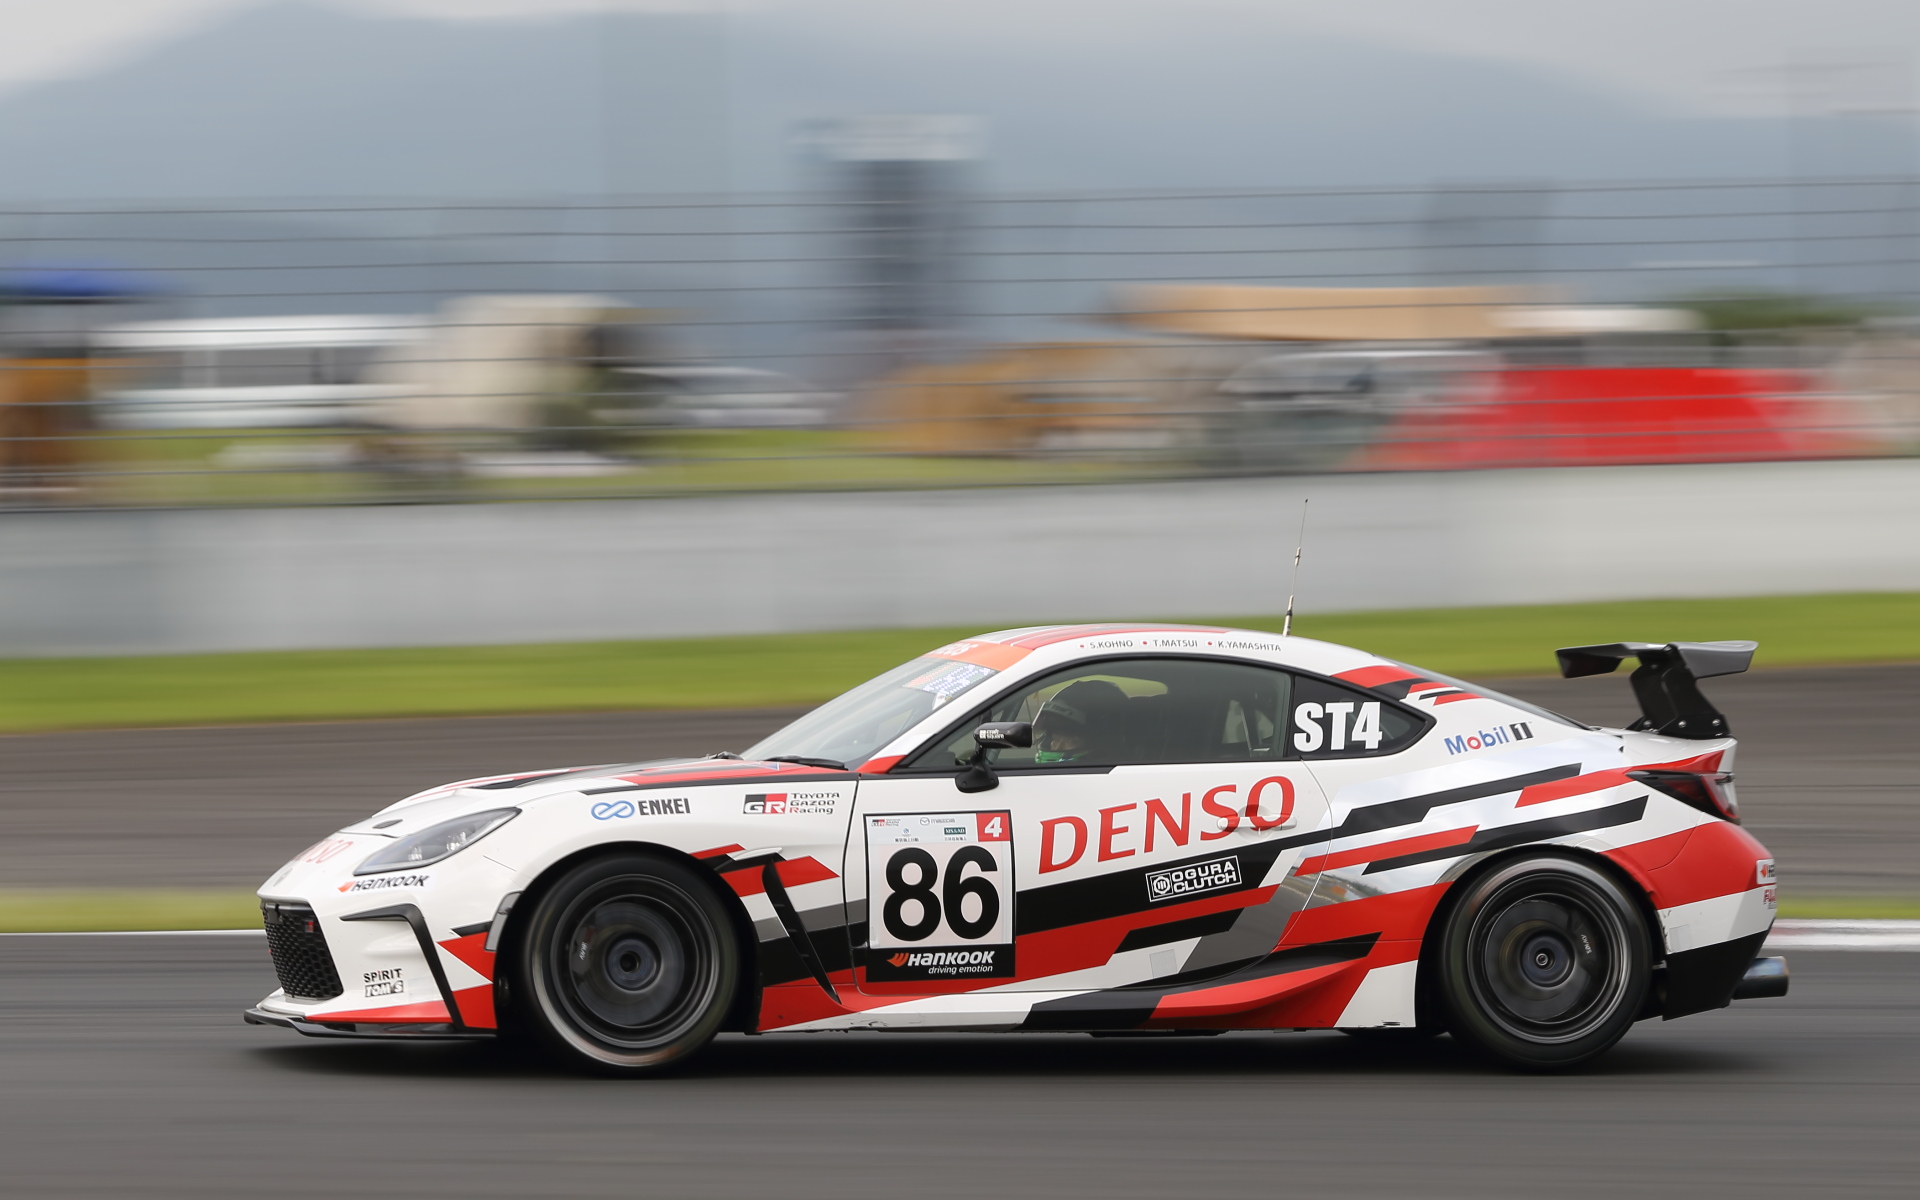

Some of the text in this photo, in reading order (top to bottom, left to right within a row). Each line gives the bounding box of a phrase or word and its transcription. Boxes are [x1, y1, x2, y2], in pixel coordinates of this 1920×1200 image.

[1089, 639, 1134, 649] S.KOHNO
[1153, 639, 1198, 648] T.MATSUI
[1217, 640, 1281, 651] K.YAMASHITA
[1293, 701, 1383, 752] ST4
[1443, 725, 1510, 756] Mobil
[637, 798, 691, 816] ENKEI
[744, 800, 787, 814] GR
[789, 806, 834, 815] Racing
[984, 816, 1003, 838] 4
[1038, 775, 1296, 875] DENSO
[1171, 861, 1235, 882] OGURA
[1173, 871, 1237, 893] CLUTCH
[882, 845, 1000, 942] 86
[928, 964, 993, 975] driving emotion
